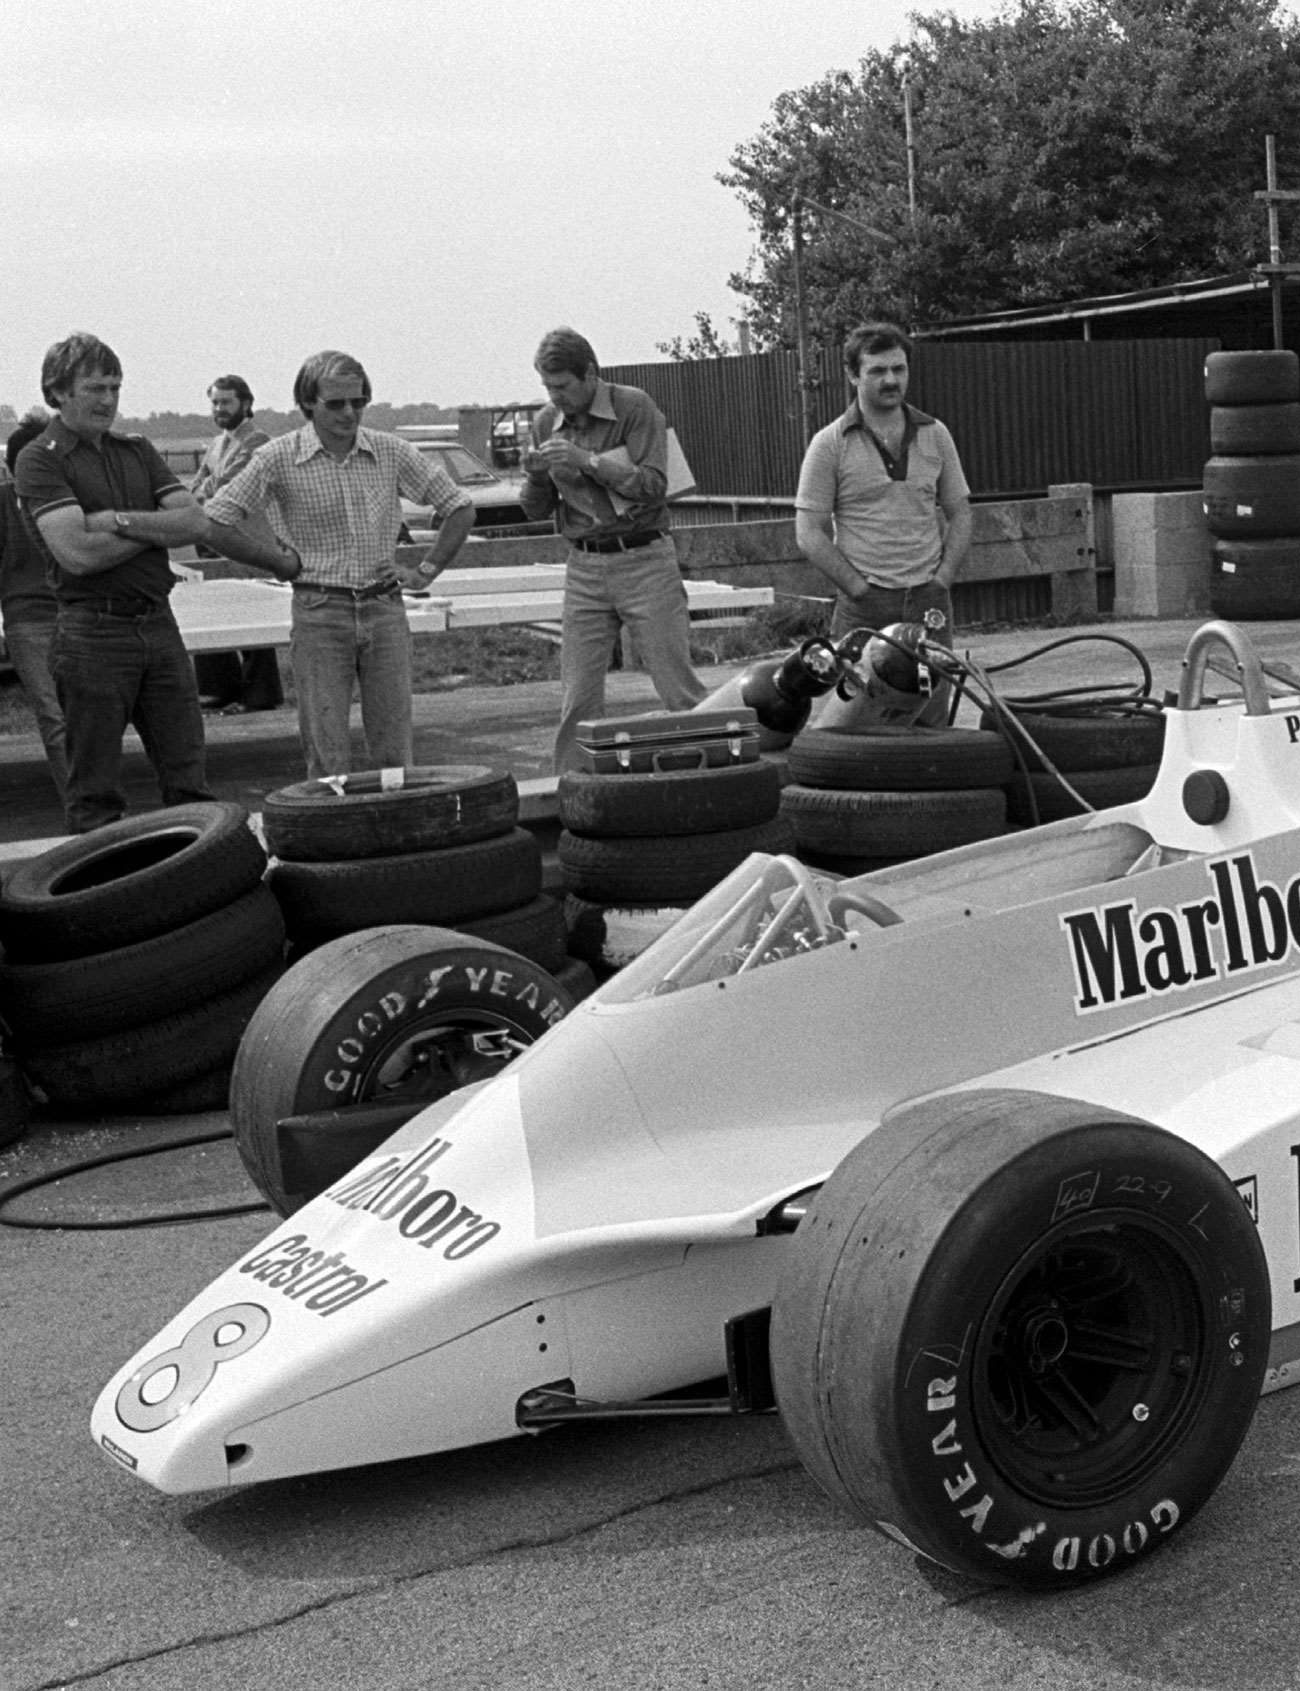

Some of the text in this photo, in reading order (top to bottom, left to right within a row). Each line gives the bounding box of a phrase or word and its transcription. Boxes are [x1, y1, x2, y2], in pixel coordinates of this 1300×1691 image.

[324, 967, 567, 1092] GOOD YEAR
[239, 1234, 389, 1317] Castrol
[115, 1302, 272, 1433] 8
[926, 1375, 1180, 1571] GOOD YEAR
